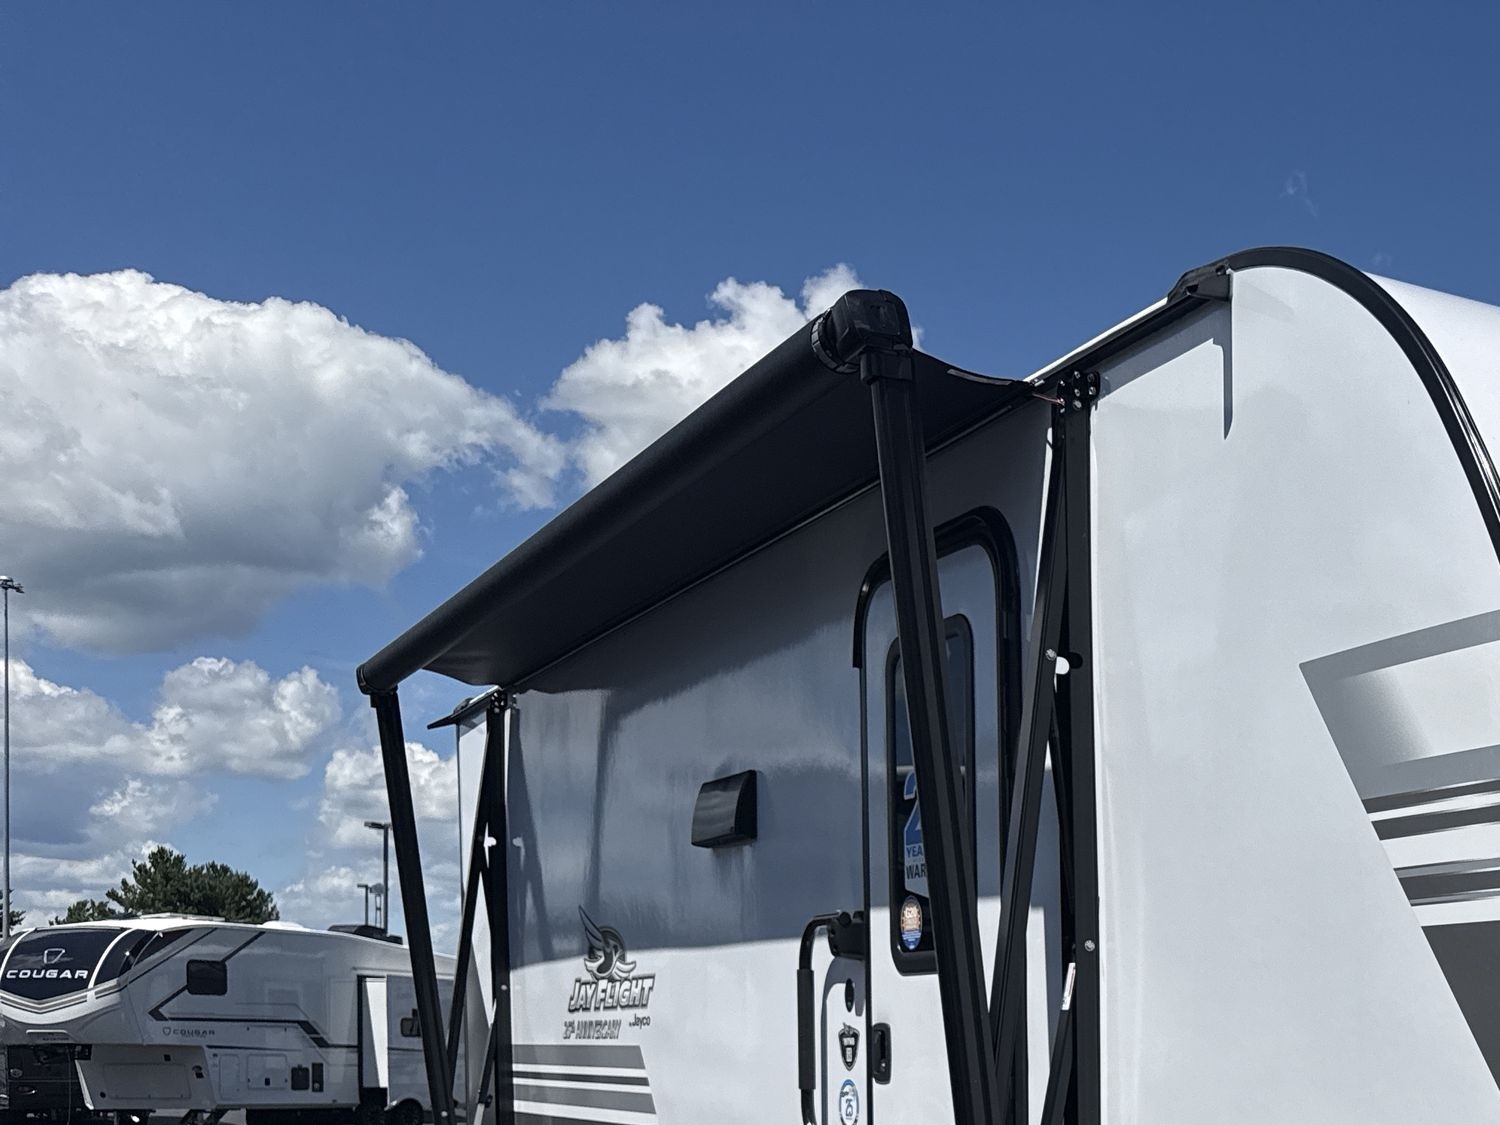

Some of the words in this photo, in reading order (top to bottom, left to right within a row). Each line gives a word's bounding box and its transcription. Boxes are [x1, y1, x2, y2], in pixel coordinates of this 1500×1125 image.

[6, 969, 89, 979] COUGAR
[568, 978, 598, 1013] JAY
[594, 974, 656, 1011] FLIGHT
